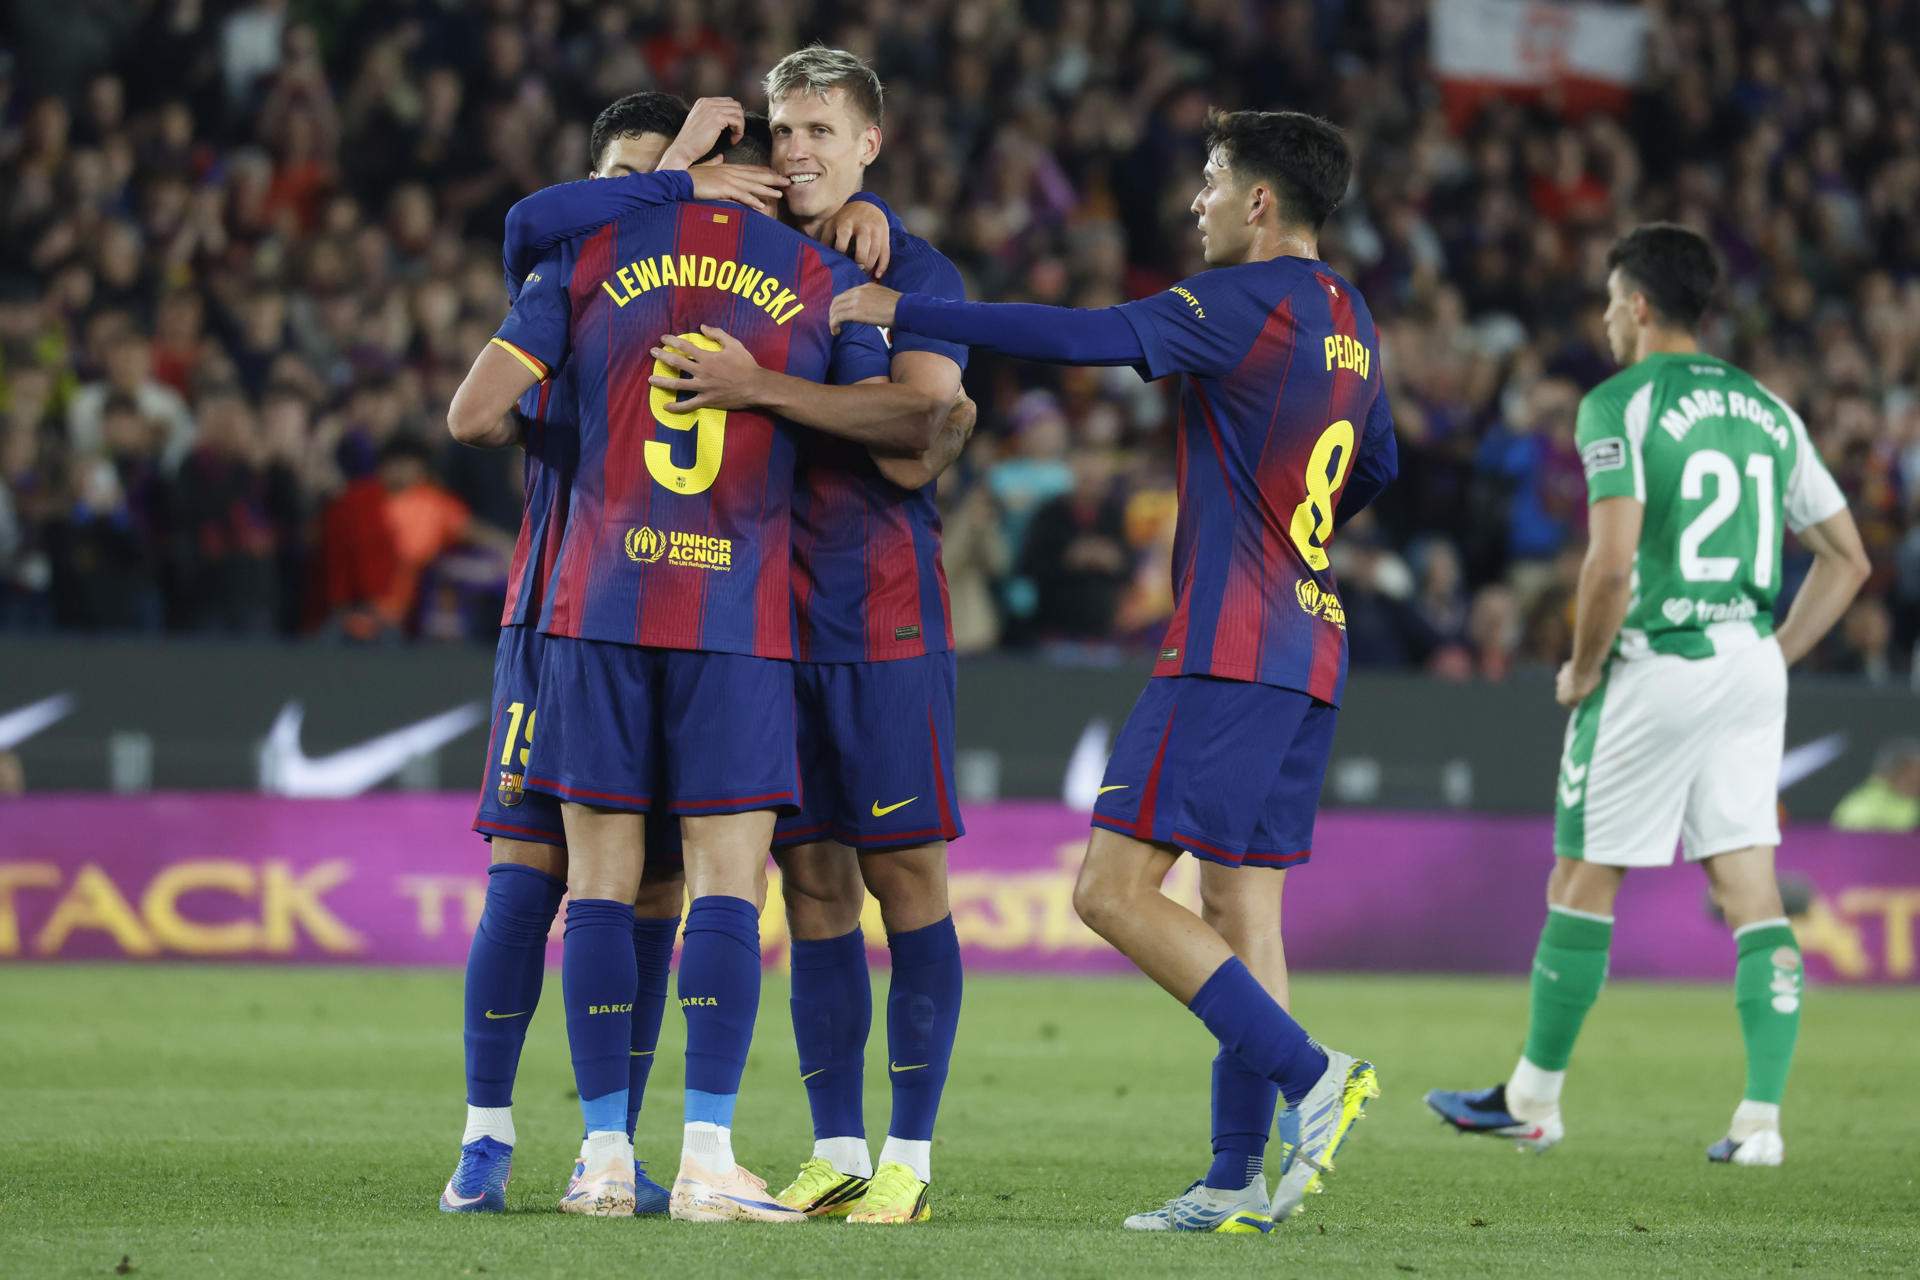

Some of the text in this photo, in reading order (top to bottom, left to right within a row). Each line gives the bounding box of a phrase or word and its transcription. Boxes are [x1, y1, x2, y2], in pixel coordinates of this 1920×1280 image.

[602, 255, 805, 326] LEWANDOWSKI
[1324, 334, 1370, 381] PEDRI
[644, 332, 728, 495] 9
[1659, 389, 1789, 450] MARC ROCA
[1290, 419, 1355, 571] 8
[1679, 449, 1775, 588] 21
[668, 545, 732, 565] ACNUR
[670, 531, 732, 553] UNHCR
[688, 561, 711, 569] Refugee
[711, 564, 731, 572] Agency
